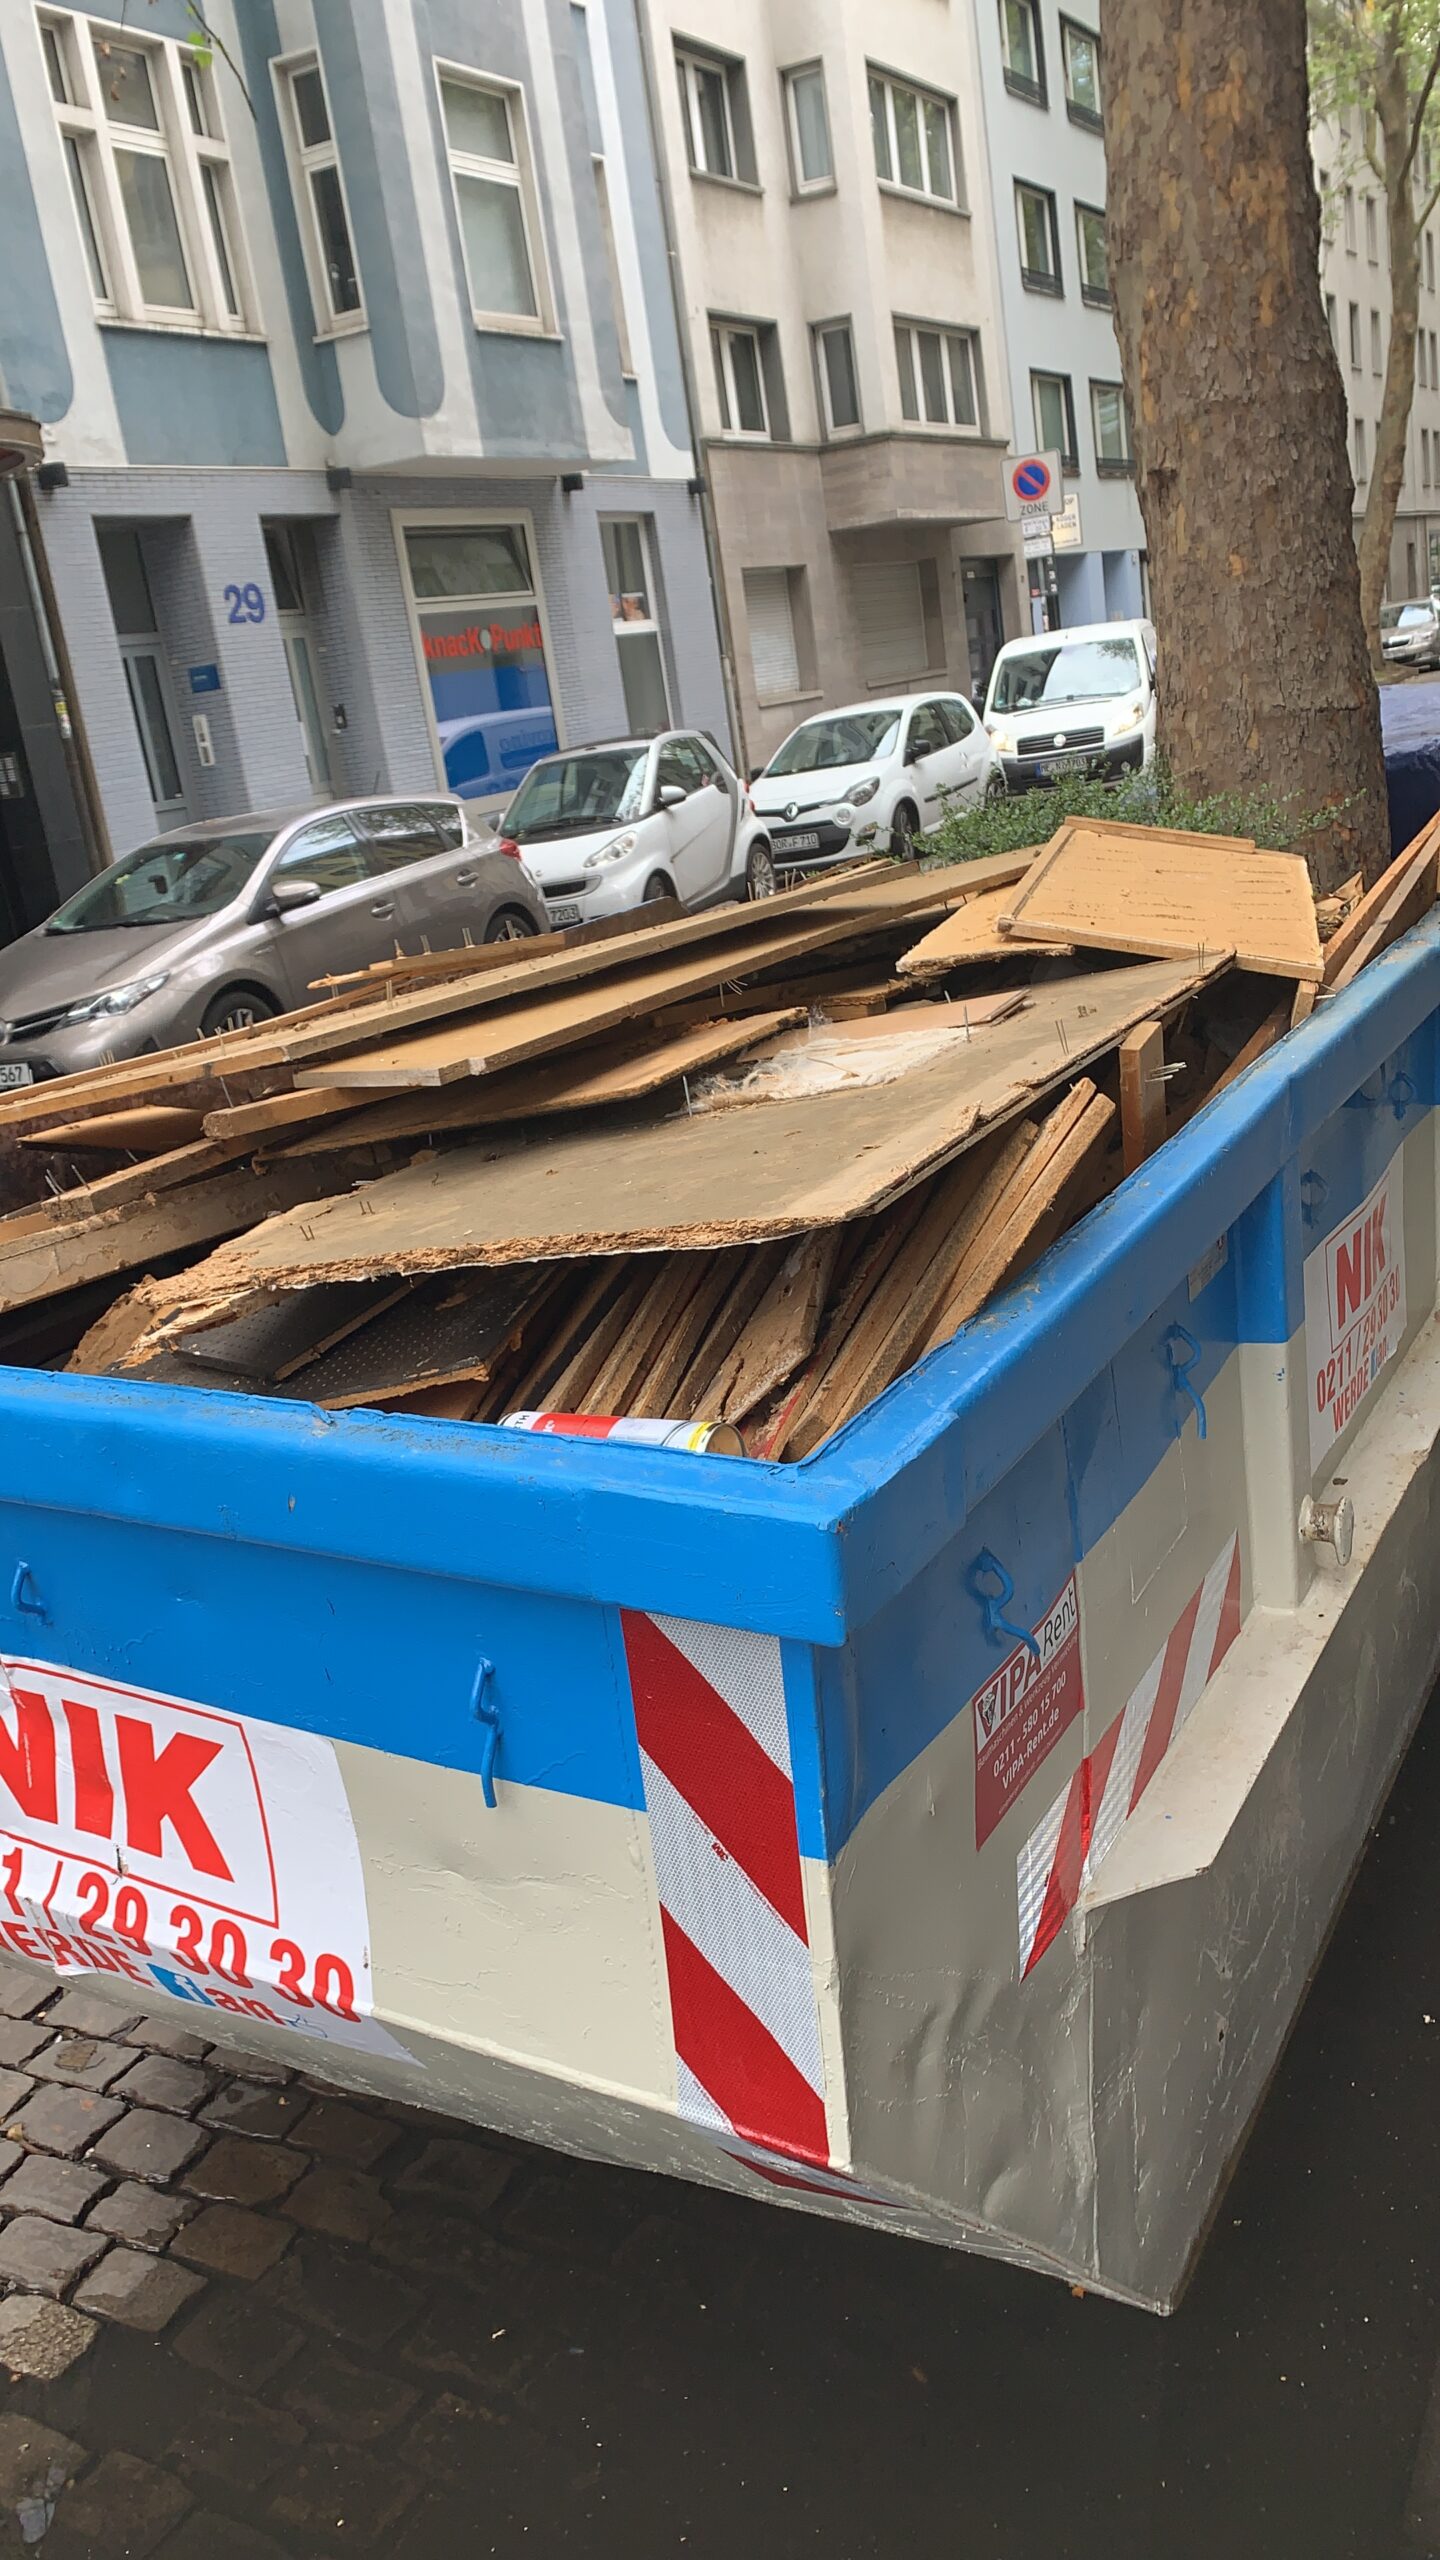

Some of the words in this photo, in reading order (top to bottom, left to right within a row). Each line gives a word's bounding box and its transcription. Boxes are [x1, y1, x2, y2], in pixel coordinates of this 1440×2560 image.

[1021, 501, 1048, 515] ZONE
[224, 582, 265, 623] 29
[489, 623, 544, 652] Punkt
[792, 836, 798, 847] F
[800, 834, 817, 845] 710
[0, 1066, 21, 1083] 567
[1336, 1191, 1387, 1330] NIK
[1316, 1337, 1351, 1413] 0211
[1377, 1284, 1388, 1333] 30
[1332, 1358, 1369, 1433] WERDE
[977, 1650, 1042, 1739] VIPA
[1043, 1588, 1077, 1656] Rent
[993, 1738, 1015, 1778] 0211
[1022, 1708, 1038, 1740] 580
[1040, 1692, 1050, 1715] 15
[1051, 1671, 1067, 1700] 700
[1002, 1707, 1060, 1790] VIPA-Rent.de
[0, 1689, 235, 1883] NIK
[0, 1920, 155, 1988] ERDE
[76, 1872, 152, 1956] 29
[170, 1904, 254, 1989] 30
[269, 1938, 361, 2023] 30
